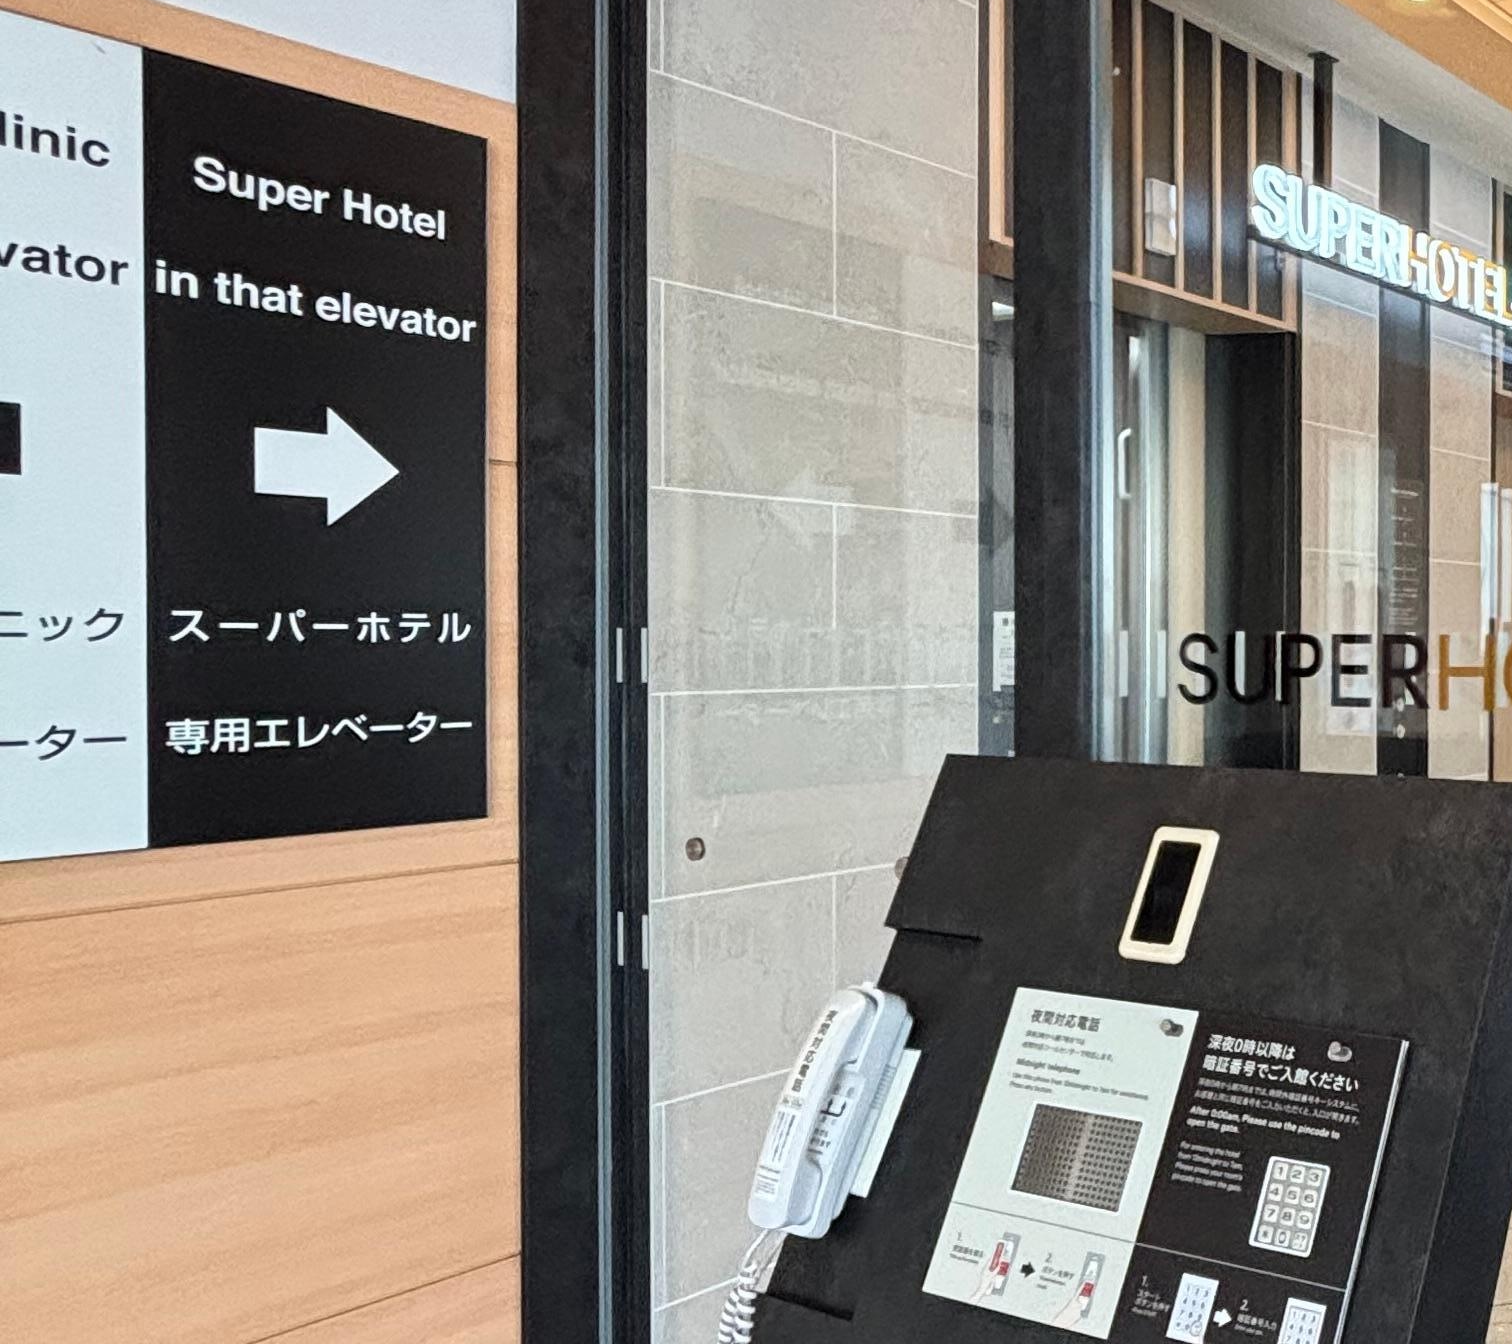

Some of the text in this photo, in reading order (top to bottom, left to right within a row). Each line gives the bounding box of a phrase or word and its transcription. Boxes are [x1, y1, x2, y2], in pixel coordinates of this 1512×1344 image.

[0, 110, 110, 167] linic
[193, 156, 445, 240] Super Hotel
[155, 259, 477, 342] in that elevator
[0, 608, 124, 643] ニック
[169, 608, 471, 644] スーパーホテル
[165, 711, 473, 755] 専用エレベーター
[1207, 1033, 1296, 1061] 深夜0時以降は
[1202, 1054, 1359, 1093] 暗証番号でご入館ください
[1186, 1118, 1206, 1128] open
[1206, 1119, 1220, 1130] the
[1189, 1106, 1210, 1117] After
[1242, 1113, 1267, 1127] Please
[1268, 1119, 1283, 1129] use
[1283, 1121, 1298, 1132] the
[1298, 1124, 1330, 1138] pincode
[1330, 1130, 1341, 1140] to
